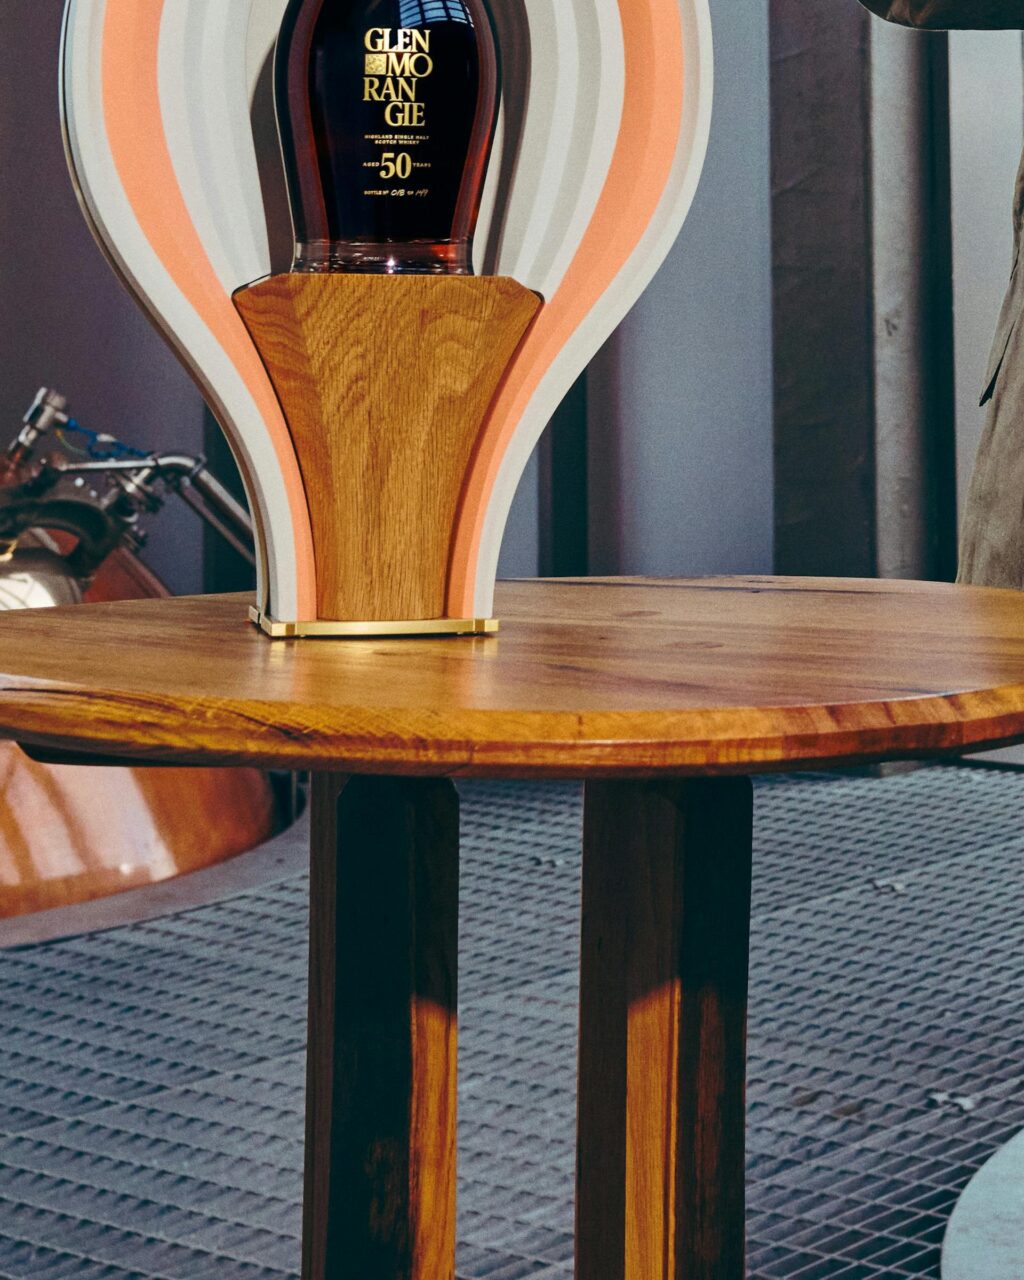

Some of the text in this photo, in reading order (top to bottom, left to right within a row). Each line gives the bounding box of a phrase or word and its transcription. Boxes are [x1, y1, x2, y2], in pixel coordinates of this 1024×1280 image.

[364, 28, 431, 53] GLEN
[388, 53, 433, 78] MO
[363, 77, 417, 101] RAN
[384, 102, 425, 126] GIE
[379, 152, 412, 179] 50
